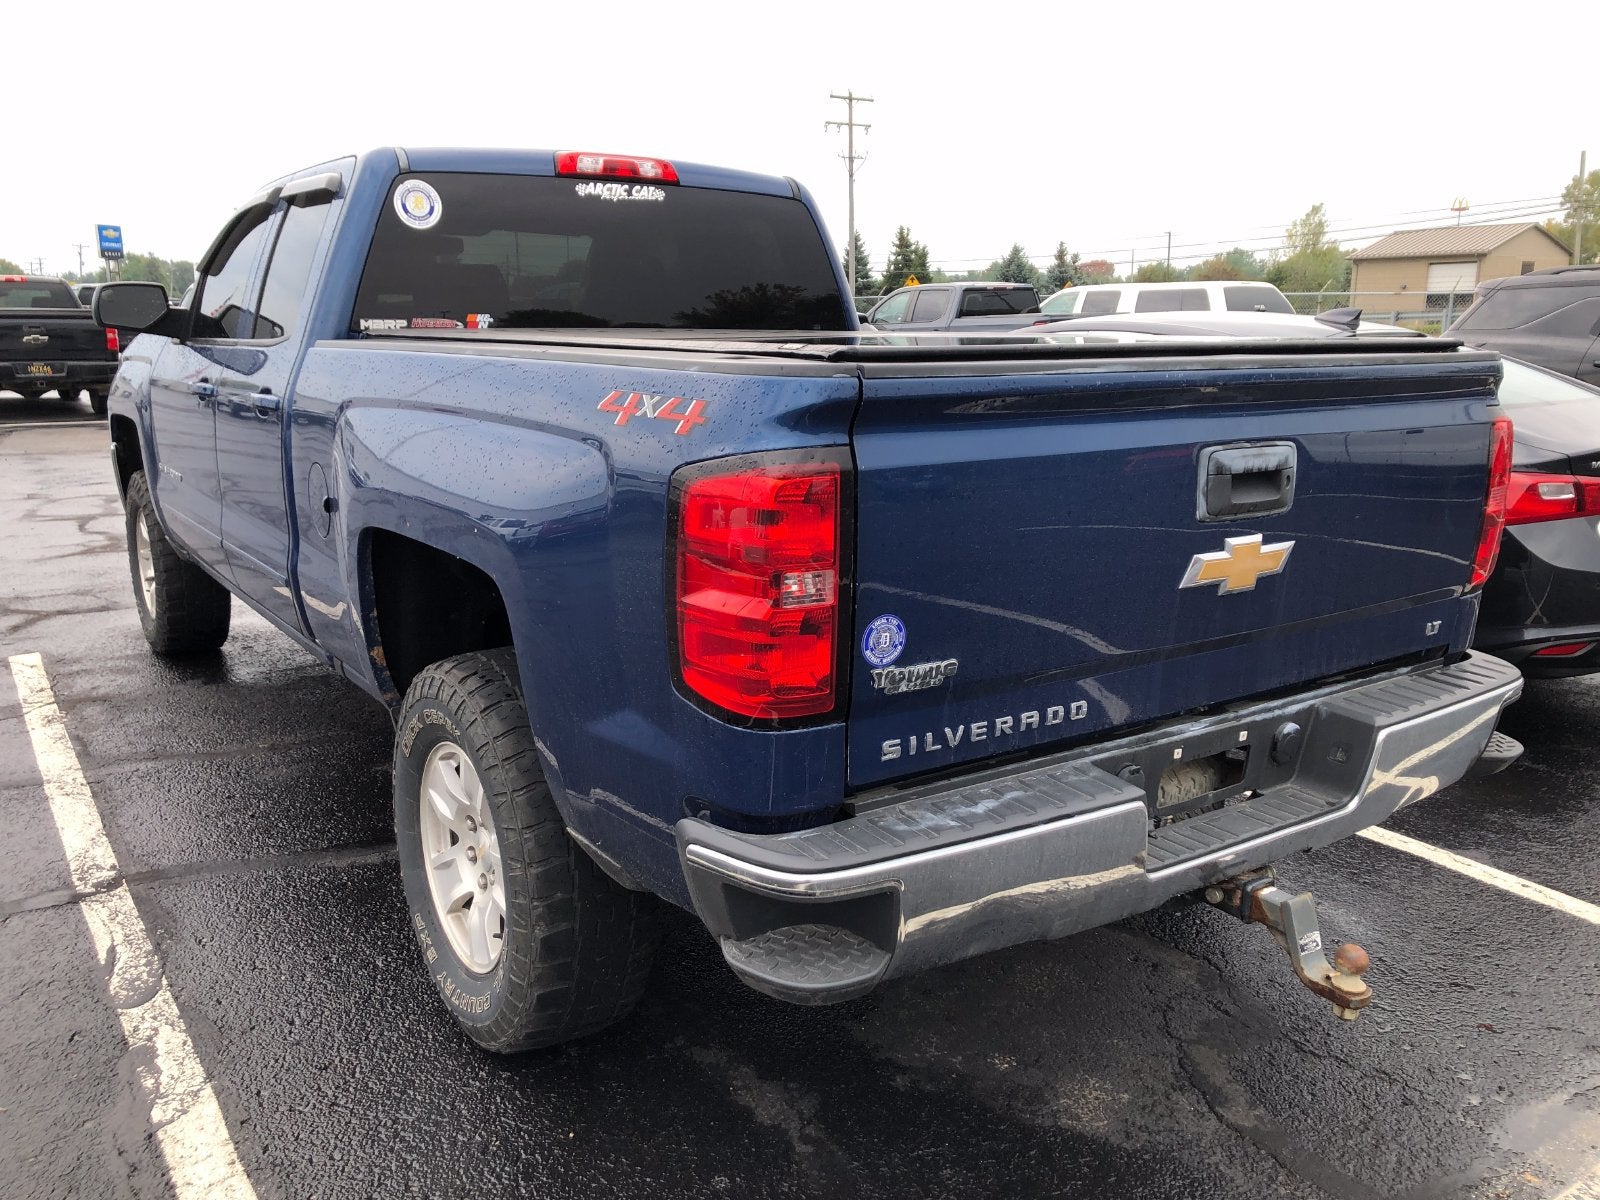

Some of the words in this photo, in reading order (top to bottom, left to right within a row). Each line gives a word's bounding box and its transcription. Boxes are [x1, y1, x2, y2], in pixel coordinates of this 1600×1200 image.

[584, 182, 630, 197] ARCTIC
[631, 185, 656, 198] CAT
[360, 319, 408, 330] MBRP
[1426, 620, 1442, 636] LT
[402, 713, 424, 758] DICK
[881, 700, 1089, 762] SILVERADO
[437, 971, 492, 1014] COUNTRY
